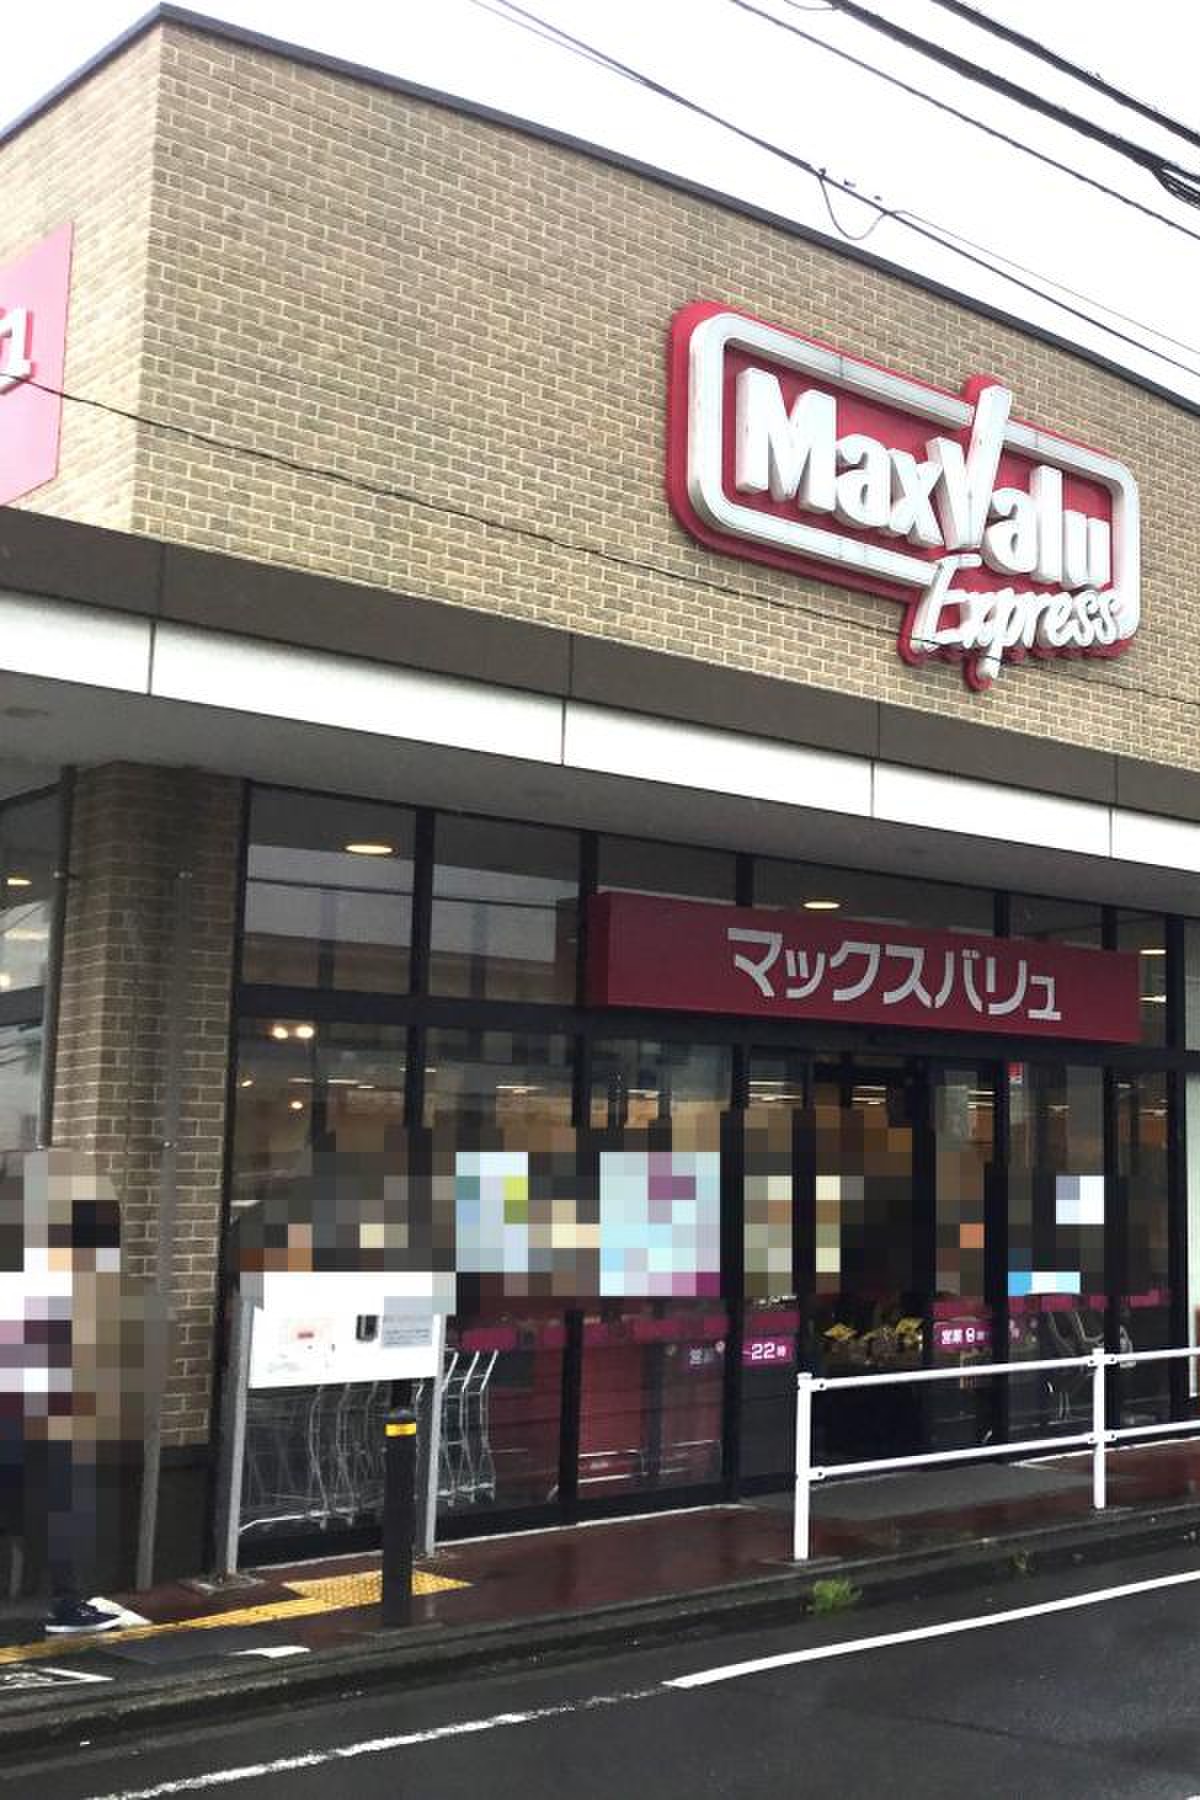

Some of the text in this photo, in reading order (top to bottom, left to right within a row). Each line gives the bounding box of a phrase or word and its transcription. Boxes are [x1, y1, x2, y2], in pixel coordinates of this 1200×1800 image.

[736, 367, 1111, 590] MaxValu
[909, 554, 1124, 680] Express
[726, 927, 1062, 1021] マックスバリュ
